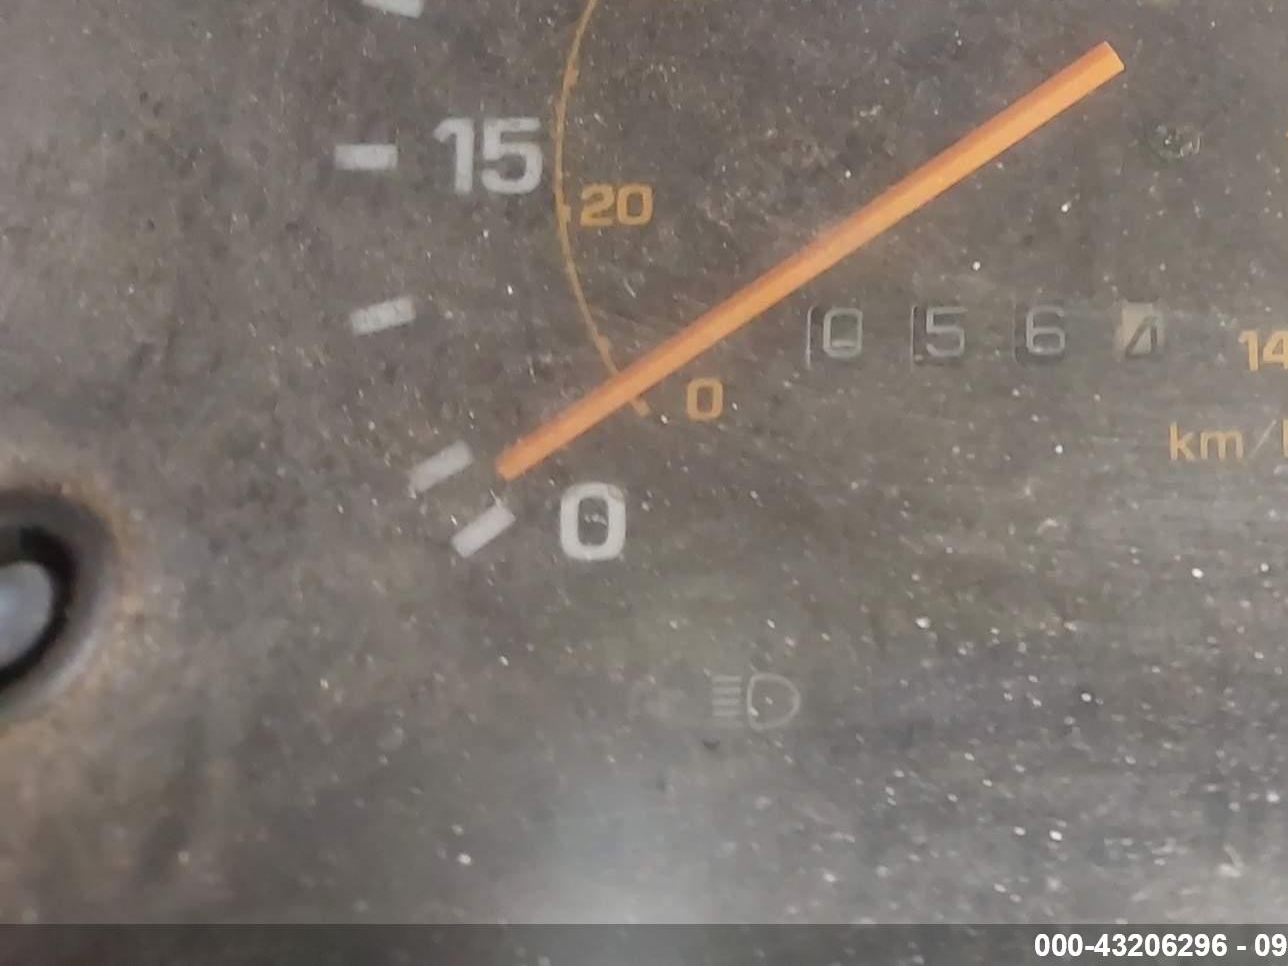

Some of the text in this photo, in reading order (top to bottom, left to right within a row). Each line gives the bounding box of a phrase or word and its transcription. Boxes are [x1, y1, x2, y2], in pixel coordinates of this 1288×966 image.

[433, 116, 544, 196] 15
[580, 183, 654, 227] 20
[686, 378, 724, 421] 0
[559, 482, 627, 560] 0
